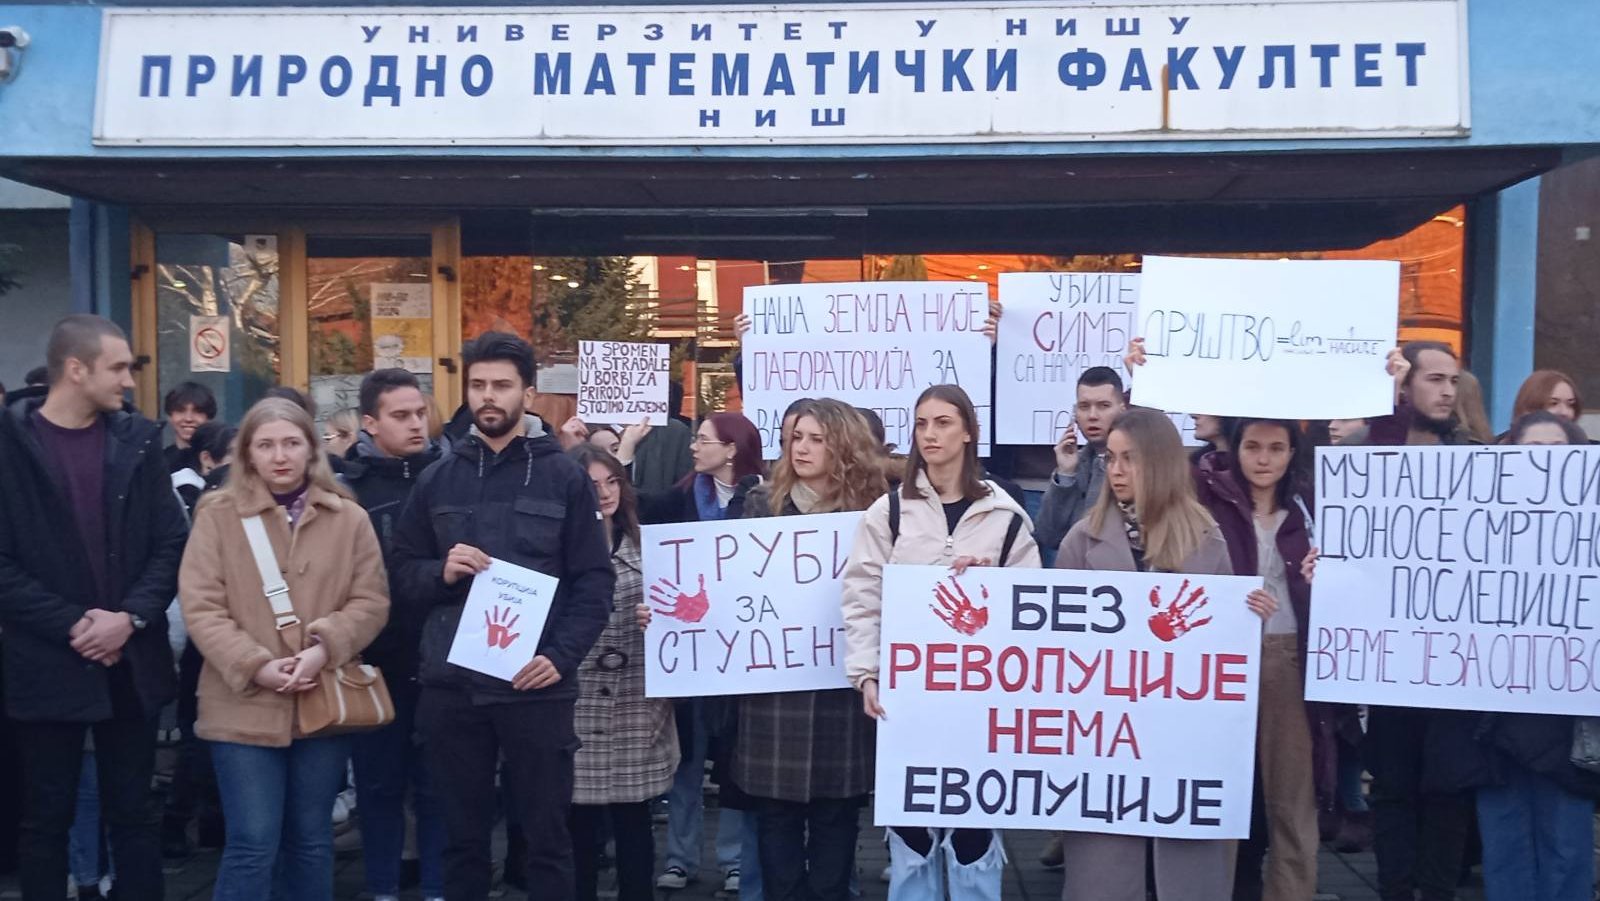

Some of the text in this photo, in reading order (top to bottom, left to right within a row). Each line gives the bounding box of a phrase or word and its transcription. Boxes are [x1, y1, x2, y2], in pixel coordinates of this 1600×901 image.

[361, 17, 1191, 43] УНИВЕРЗИТЕТ У НИШУ
[139, 42, 1426, 106] ПРИРОДНО МАТЕМАТИЧКИ ФАКУЛТЕТ
[699, 108, 846, 127] НИШ
[753, 289, 984, 335] НАША ЗЕМЉА НИЈЕ
[580, 356, 671, 371] NA STRADALE
[583, 342, 658, 357] U SPOMEN
[748, 346, 960, 391] ЛАБОРАТОРИЈА ЗА
[1014, 354, 1036, 383] СА
[580, 371, 589, 385] U
[595, 371, 633, 386] BORBI
[636, 372, 657, 386] ZA
[579, 400, 668, 415] STOJIMO ZAJEDNO
[1322, 447, 1522, 506] МУТАЦИЈЕ
[1526, 450, 1550, 506] У
[1316, 505, 1459, 563] ДОНОСЕ
[736, 595, 779, 623] ЗА
[1011, 584, 1126, 633] БЕЗ
[1390, 566, 1598, 634] ПОСЛЕДИЦЕ
[889, 642, 1248, 702] РЕВОЛУЦИЈЕ
[1308, 627, 1399, 683] ВРЕМЕ
[1409, 626, 1444, 686] ЈЕ
[1446, 632, 1482, 687] ЗА
[988, 708, 1142, 760] НЕМА
[904, 766, 1224, 826] ЕВОЛУЦИЈЕ
